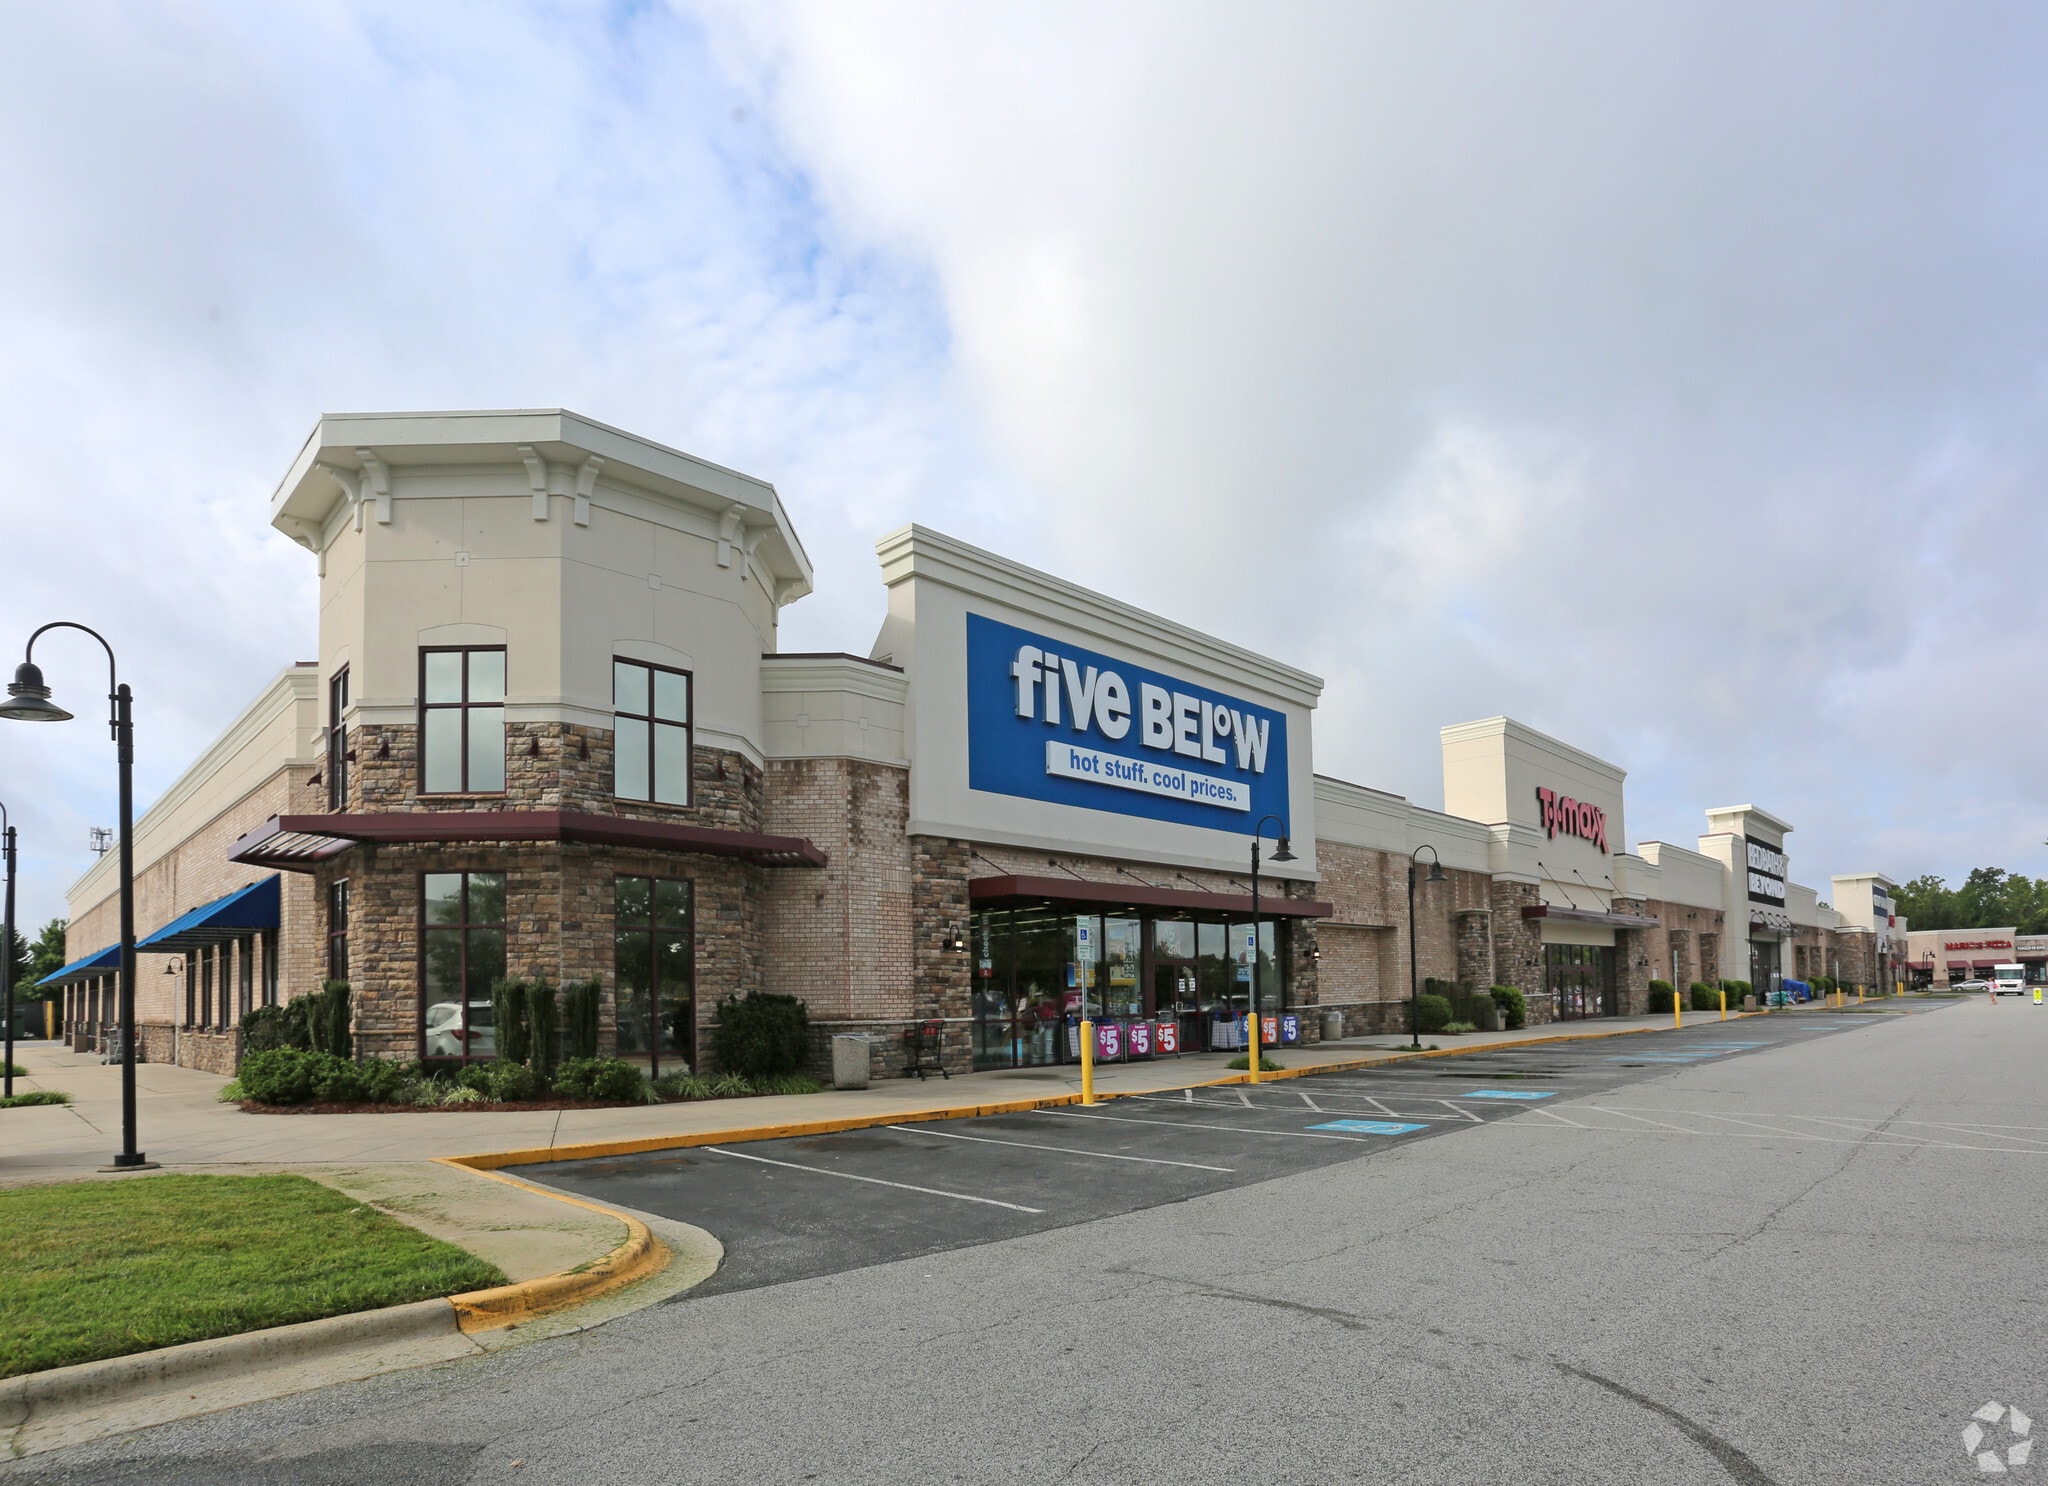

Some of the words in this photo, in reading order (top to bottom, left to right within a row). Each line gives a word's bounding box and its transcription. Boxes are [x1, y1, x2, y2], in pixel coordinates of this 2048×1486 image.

[1139, 682, 1270, 774] BELOW
[1070, 749, 1100, 774] hot
[1105, 759, 1148, 784] stuff.
[1153, 770, 1185, 791] cool
[1190, 778, 1237, 801] prices.
[1748, 872, 1786, 899] BEYOND
[1131, 1029, 1148, 1053] $5
[1158, 1028, 1175, 1051] $5
[1263, 1021, 1277, 1043] $5
[1283, 1020, 1297, 1040] $5
[1100, 1030, 1118, 1055] $5
